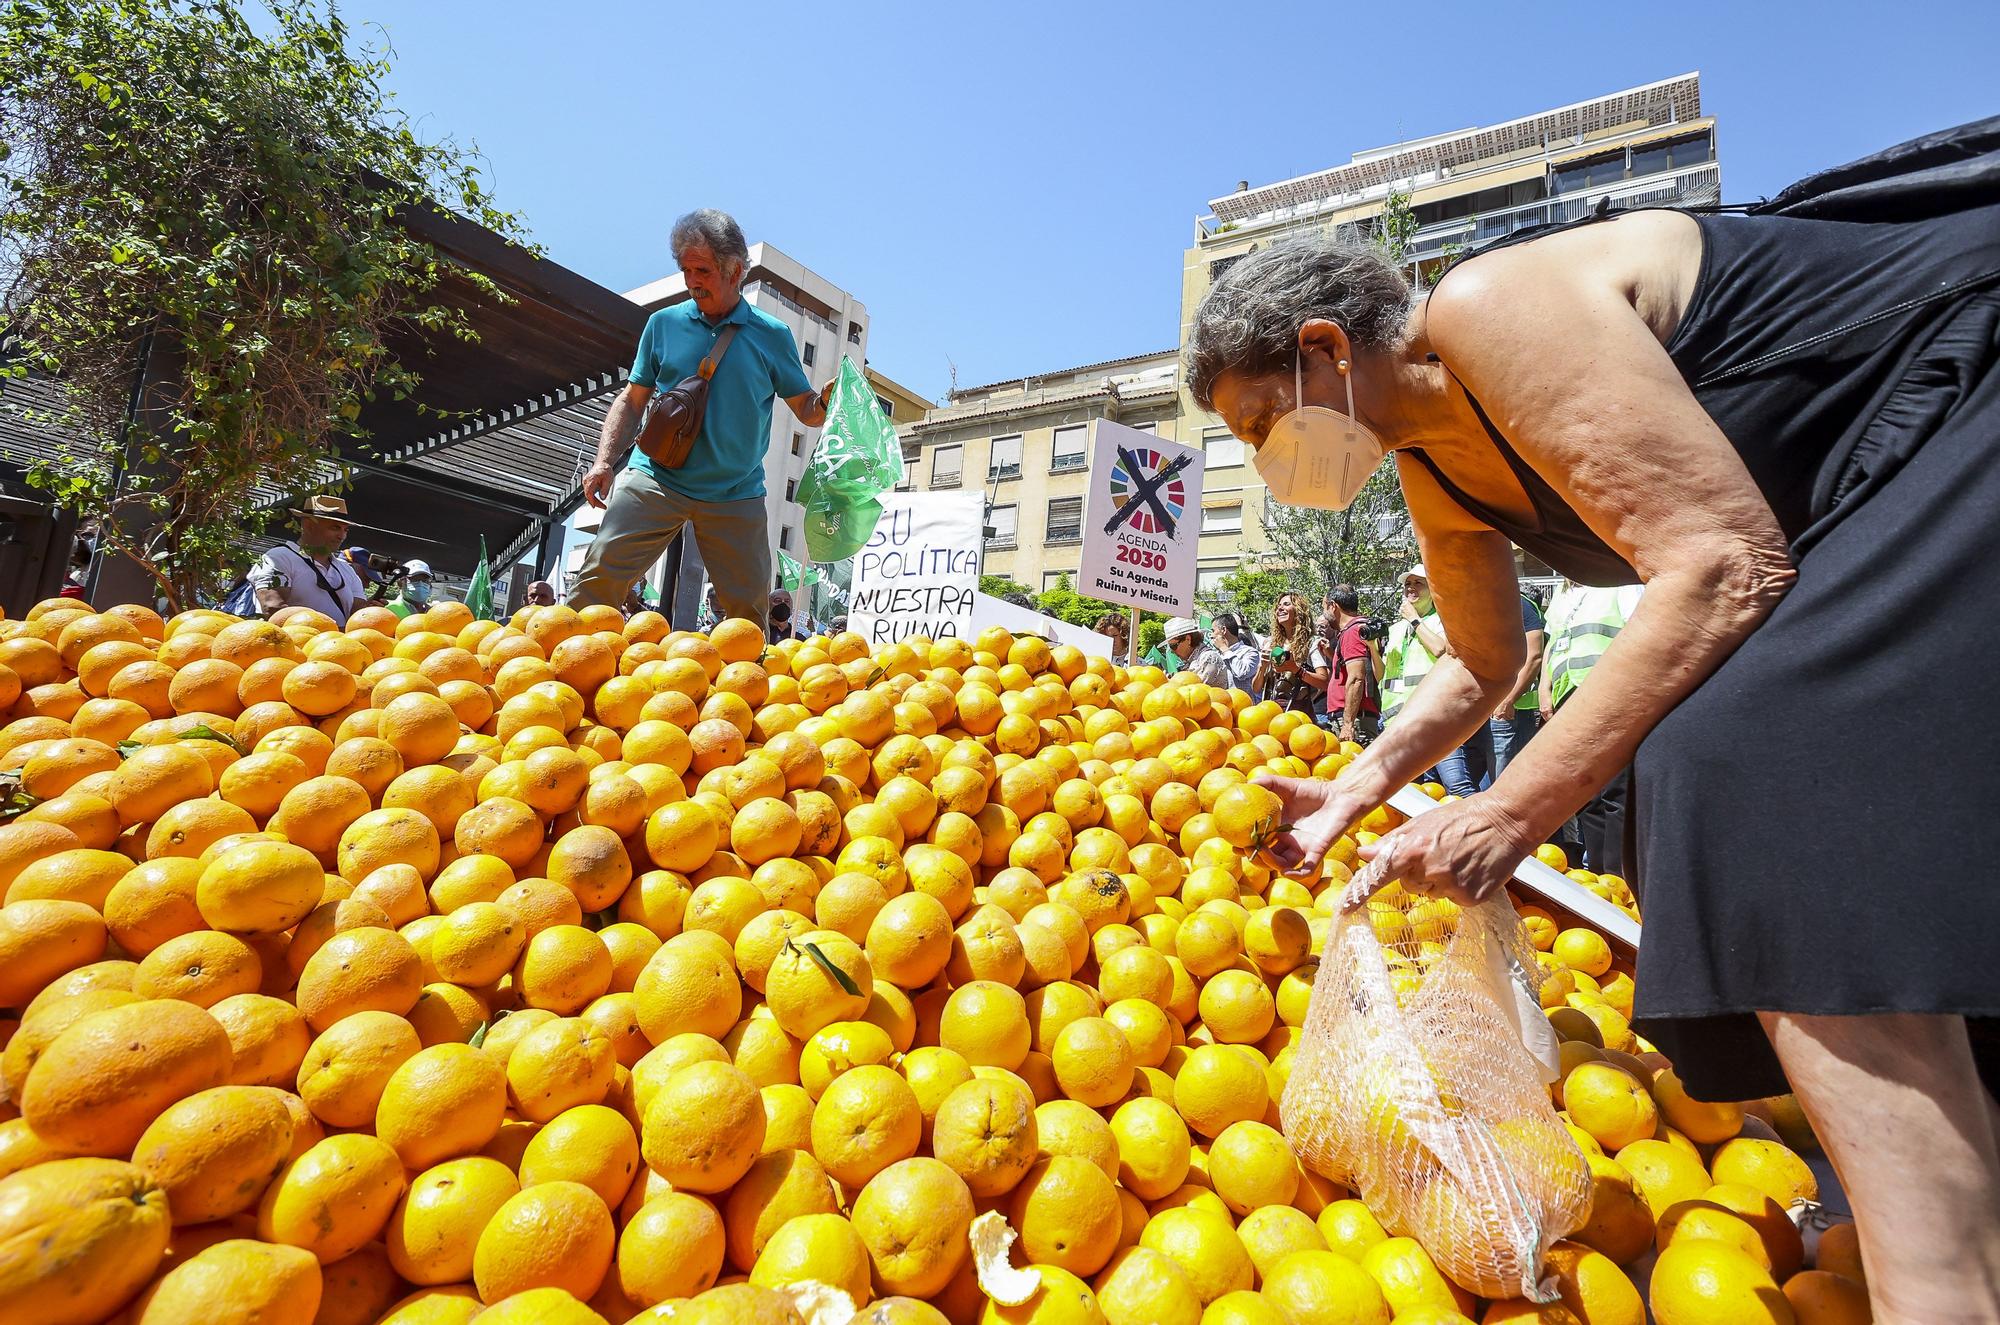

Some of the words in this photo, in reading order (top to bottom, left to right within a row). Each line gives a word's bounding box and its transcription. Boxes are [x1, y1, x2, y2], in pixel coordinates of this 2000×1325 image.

[1117, 532, 1168, 554] AGENDA
[861, 543, 978, 582] POLÍTICA
[1116, 544, 1167, 571] 2030
[1109, 566, 1124, 578] Su
[1126, 570, 1169, 588] Agenda
[852, 585, 975, 617] NUESTRA
[1095, 578, 1128, 594] Ruina
[1130, 588, 1138, 598] y
[1140, 589, 1179, 606] Miseria
[873, 618, 957, 645] RUINA
